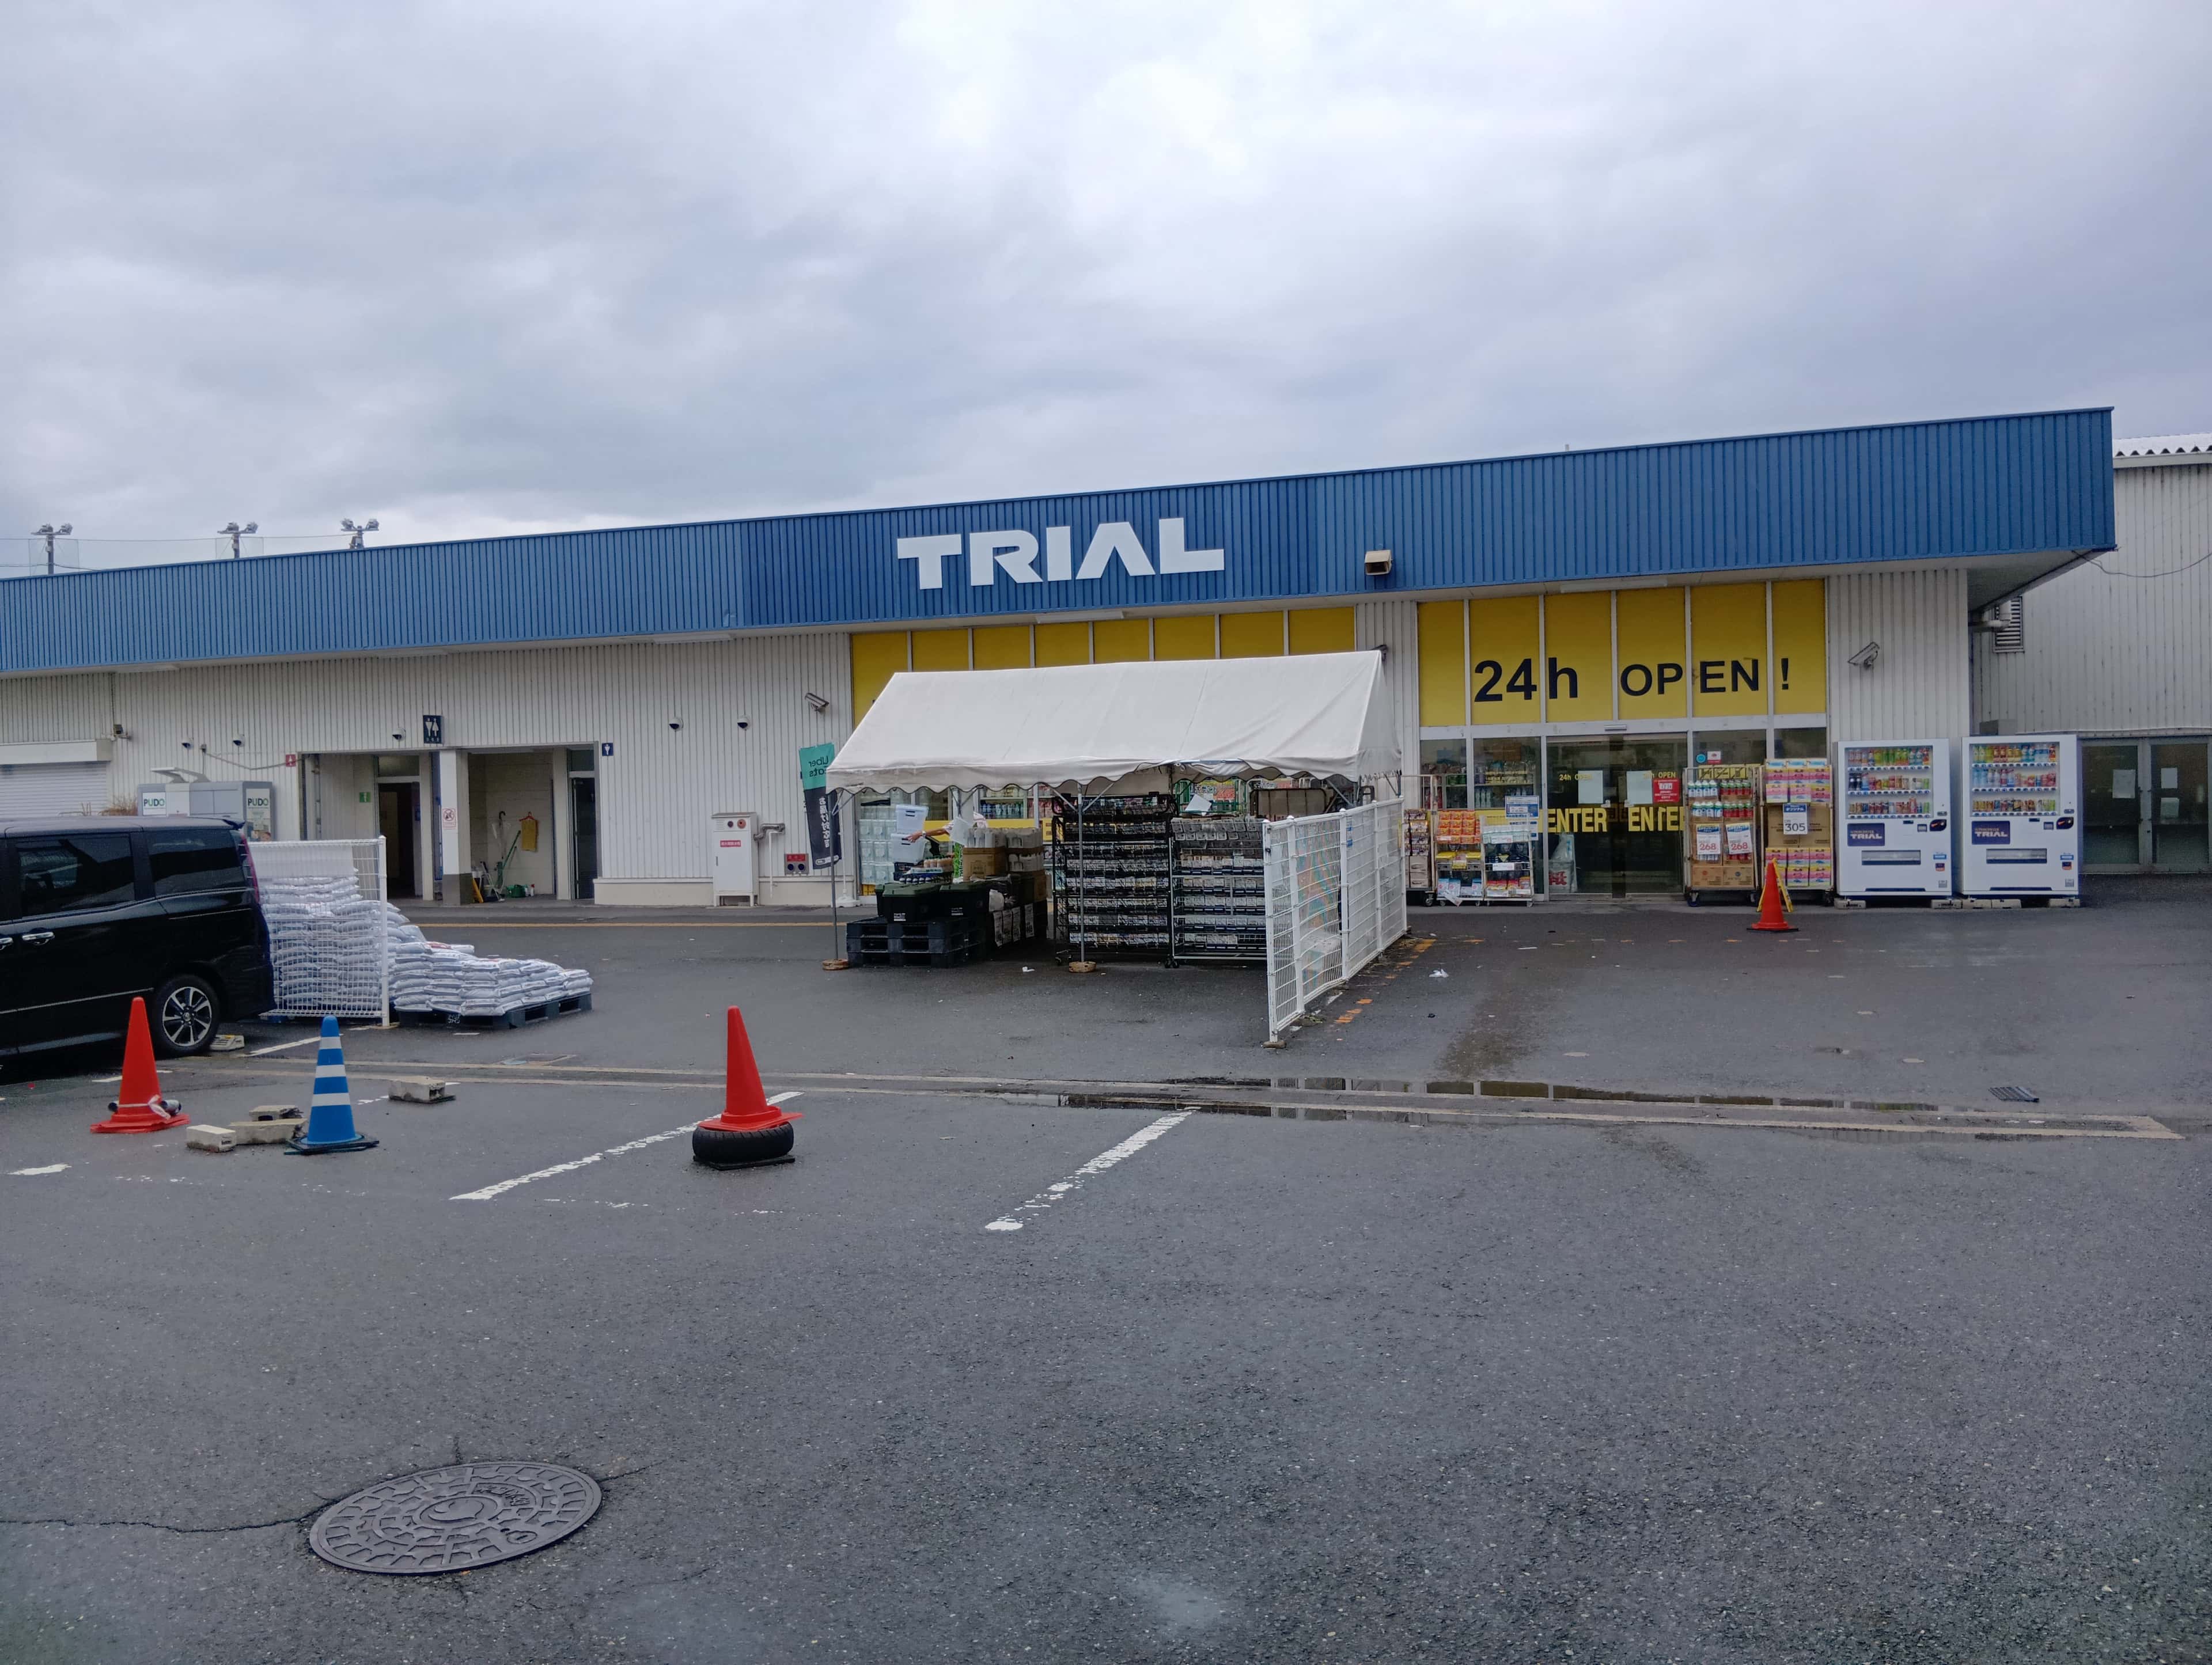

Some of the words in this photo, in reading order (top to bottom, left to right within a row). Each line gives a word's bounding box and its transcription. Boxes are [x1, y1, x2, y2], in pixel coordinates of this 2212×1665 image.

[897, 517, 1225, 590] TRIAL
[1474, 657, 1578, 703] 24h
[1620, 659, 1759, 696] OPEN
[143, 799, 165, 807] PUDO
[248, 798, 269, 806] PUDO
[1548, 808, 1607, 833] ENTER
[1785, 823, 1805, 832] 305
[1700, 843, 1717, 851] 268
[1731, 842, 1748, 851] 268
